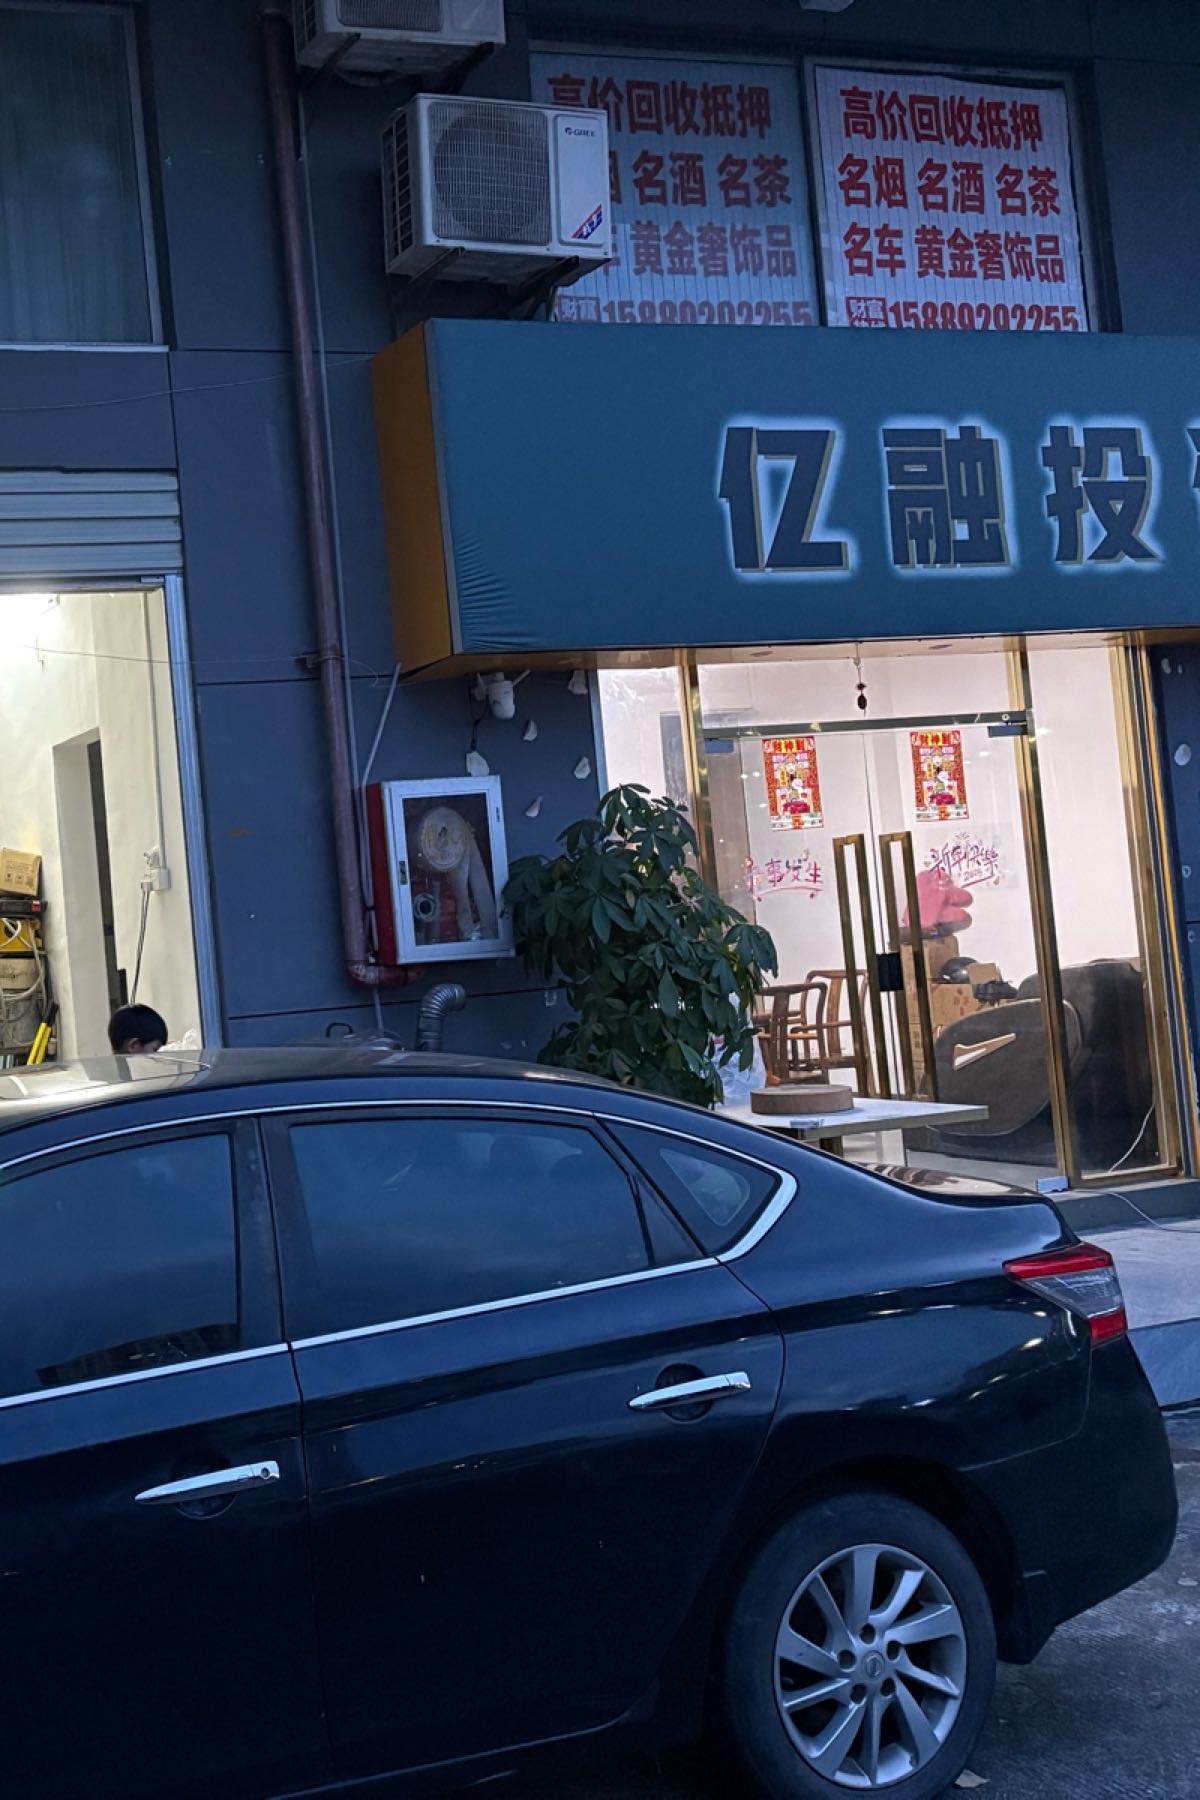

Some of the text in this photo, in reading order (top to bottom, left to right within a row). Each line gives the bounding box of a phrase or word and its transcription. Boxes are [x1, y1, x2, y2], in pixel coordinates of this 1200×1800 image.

[548, 73, 771, 139] 高价回收抵押
[839, 86, 1043, 152] 高价回收抵押
[632, 150, 707, 207] 名酒
[717, 153, 792, 208] 名茶
[838, 153, 1061, 218] 名烟 名酒 名茶
[630, 220, 797, 277] 黄金奢饰品
[843, 221, 1065, 283] 名车 黄金奢饰品
[718, 425, 1200, 573] 亿融投
